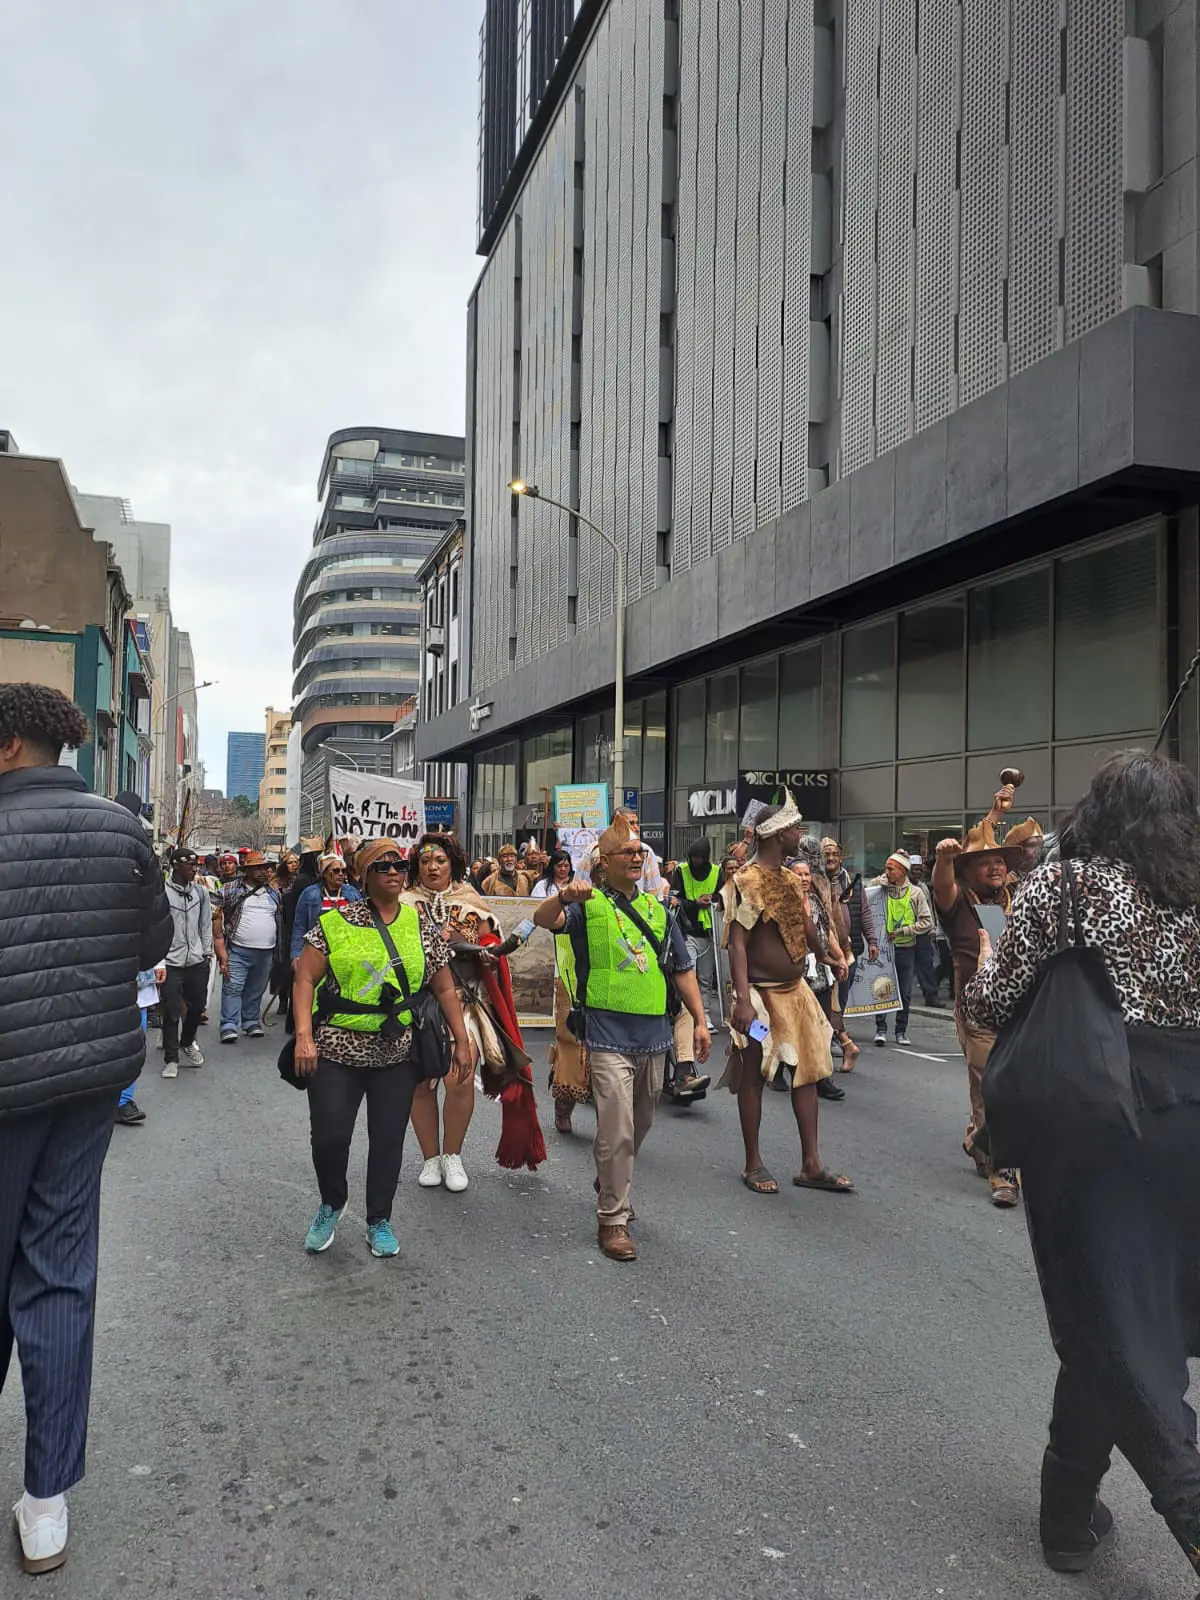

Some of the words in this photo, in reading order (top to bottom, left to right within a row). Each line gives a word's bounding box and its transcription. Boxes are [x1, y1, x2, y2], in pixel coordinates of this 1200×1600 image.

[761, 772, 828, 787] CLICKS
[626, 791, 635, 801] P
[332, 793, 355, 814] We
[361, 799, 371, 818] R
[374, 801, 399, 820] The
[401, 805, 417, 821] 1st
[334, 815, 418, 839] NATION
